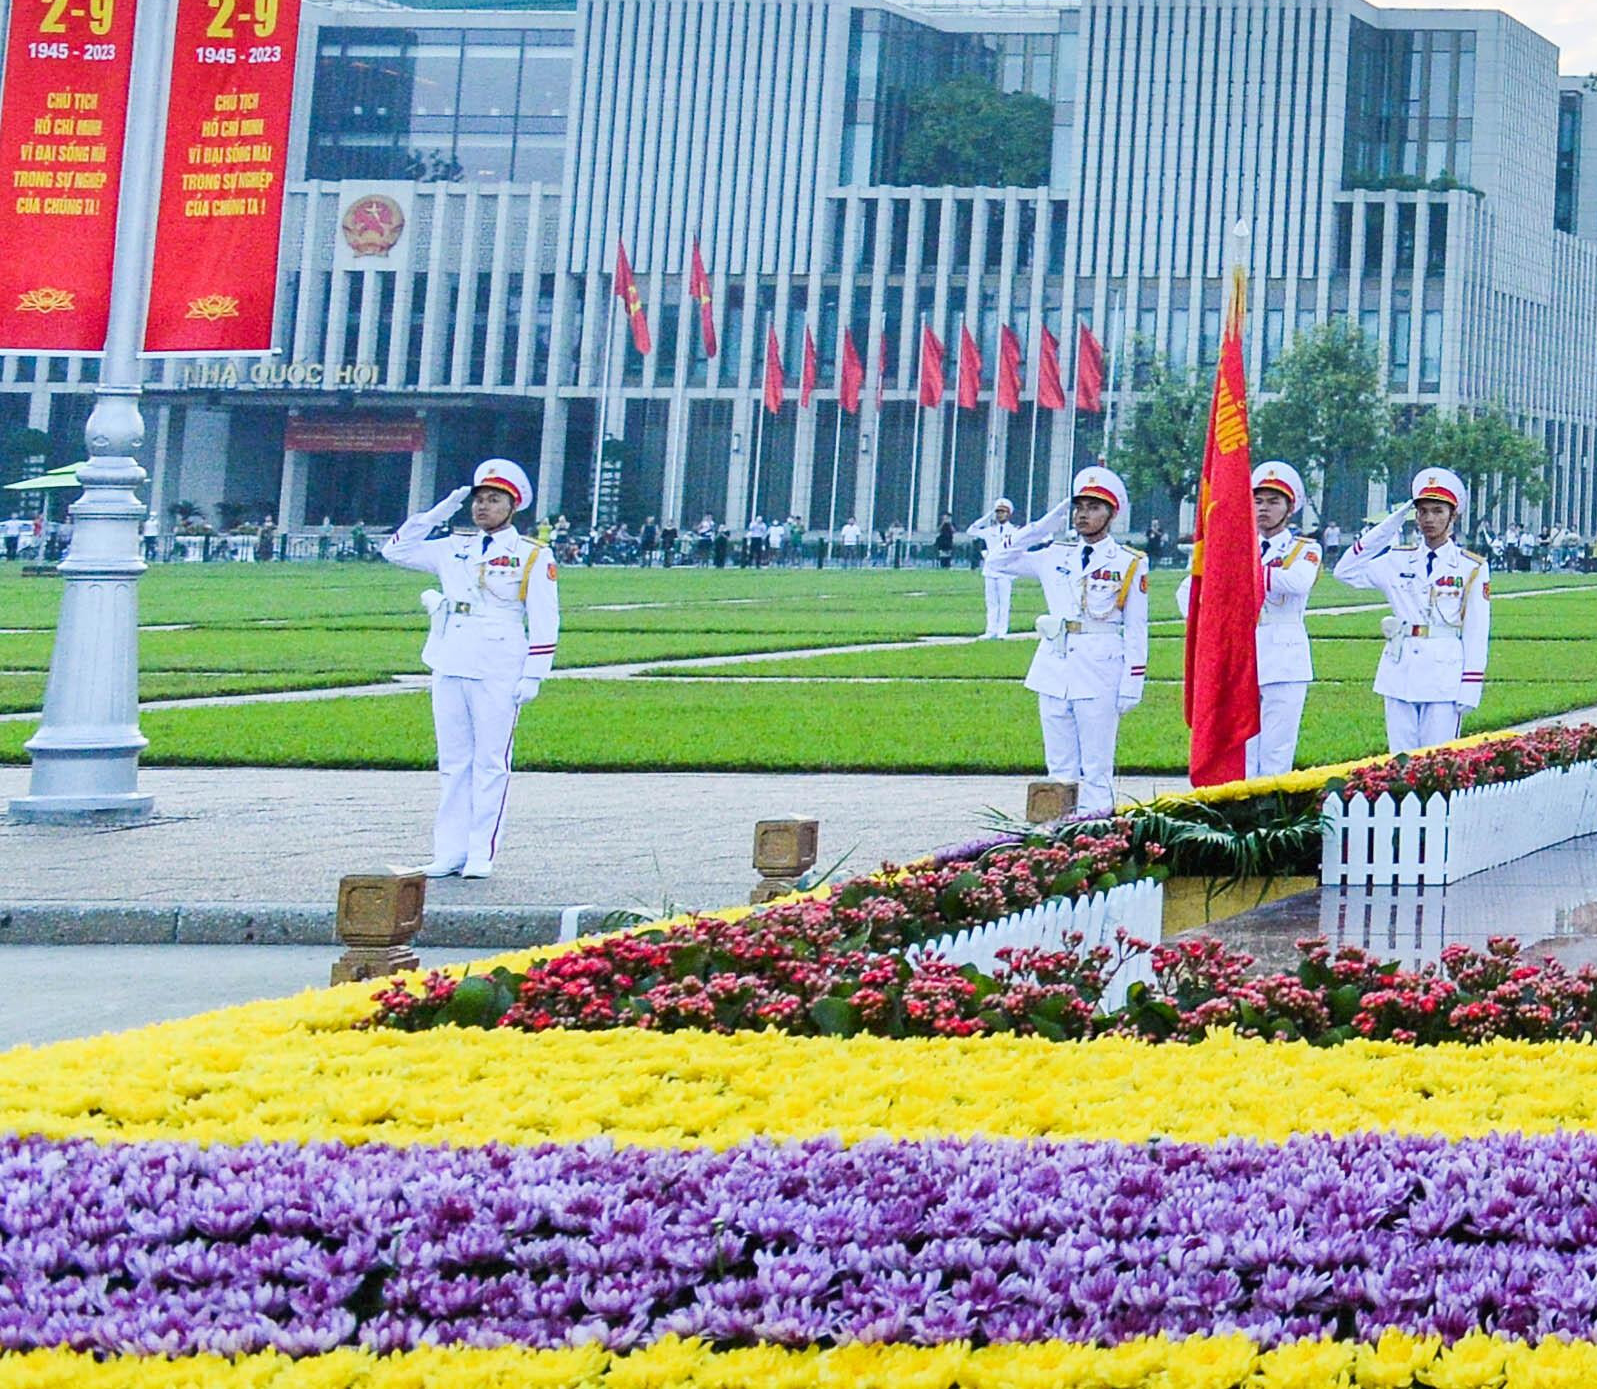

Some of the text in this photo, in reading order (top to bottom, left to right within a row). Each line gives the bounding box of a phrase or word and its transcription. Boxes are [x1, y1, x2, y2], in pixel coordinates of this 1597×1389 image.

[28, 42, 69, 59] 1945
[83, 43, 116, 60] 2023
[196, 47, 236, 64] 1945
[248, 45, 282, 63] 2023
